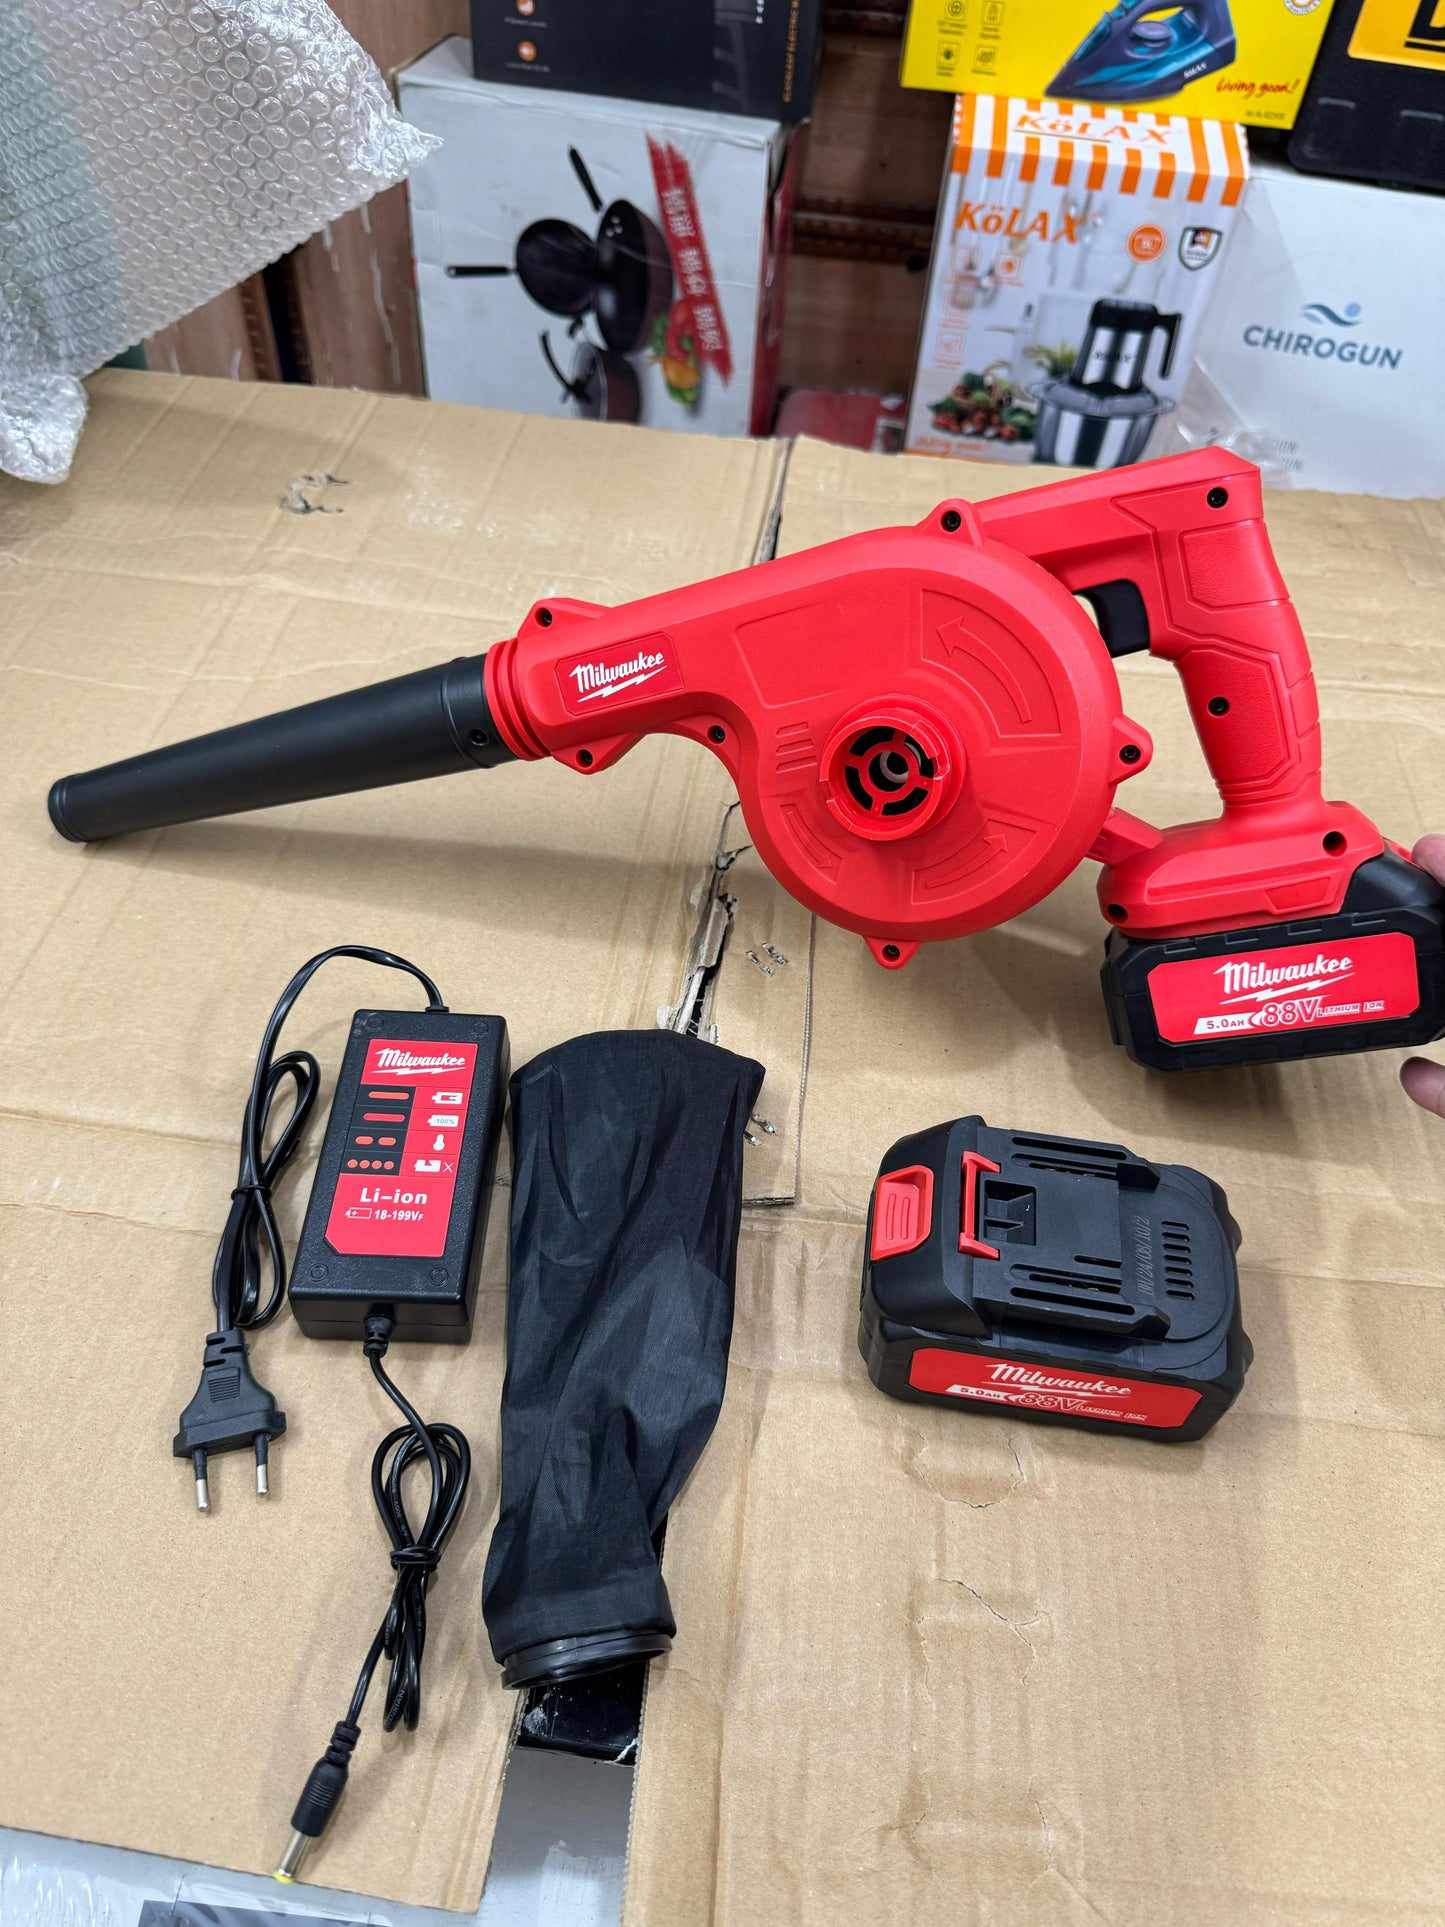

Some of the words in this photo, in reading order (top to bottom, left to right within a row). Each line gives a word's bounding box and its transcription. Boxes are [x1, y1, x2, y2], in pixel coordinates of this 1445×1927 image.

[1016, 114, 1172, 145] KöLAX
[955, 201, 1087, 245] KöLAX
[1242, 325, 1403, 370] CHIROGUN
[569, 651, 665, 694] Milwaukee
[1213, 954, 1353, 994] Milwaukee
[1206, 1018, 1245, 1030] 5.0AH
[1261, 996, 1323, 1027] 88V
[1317, 1003, 1360, 1017] LITHIUM
[1363, 1000, 1385, 1013] ION
[374, 1047, 466, 1068] Milwaukee
[360, 1187, 428, 1205] Li-ion
[984, 1363, 1132, 1395] Milwaukee
[1019, 1391, 1082, 1411] 88V
